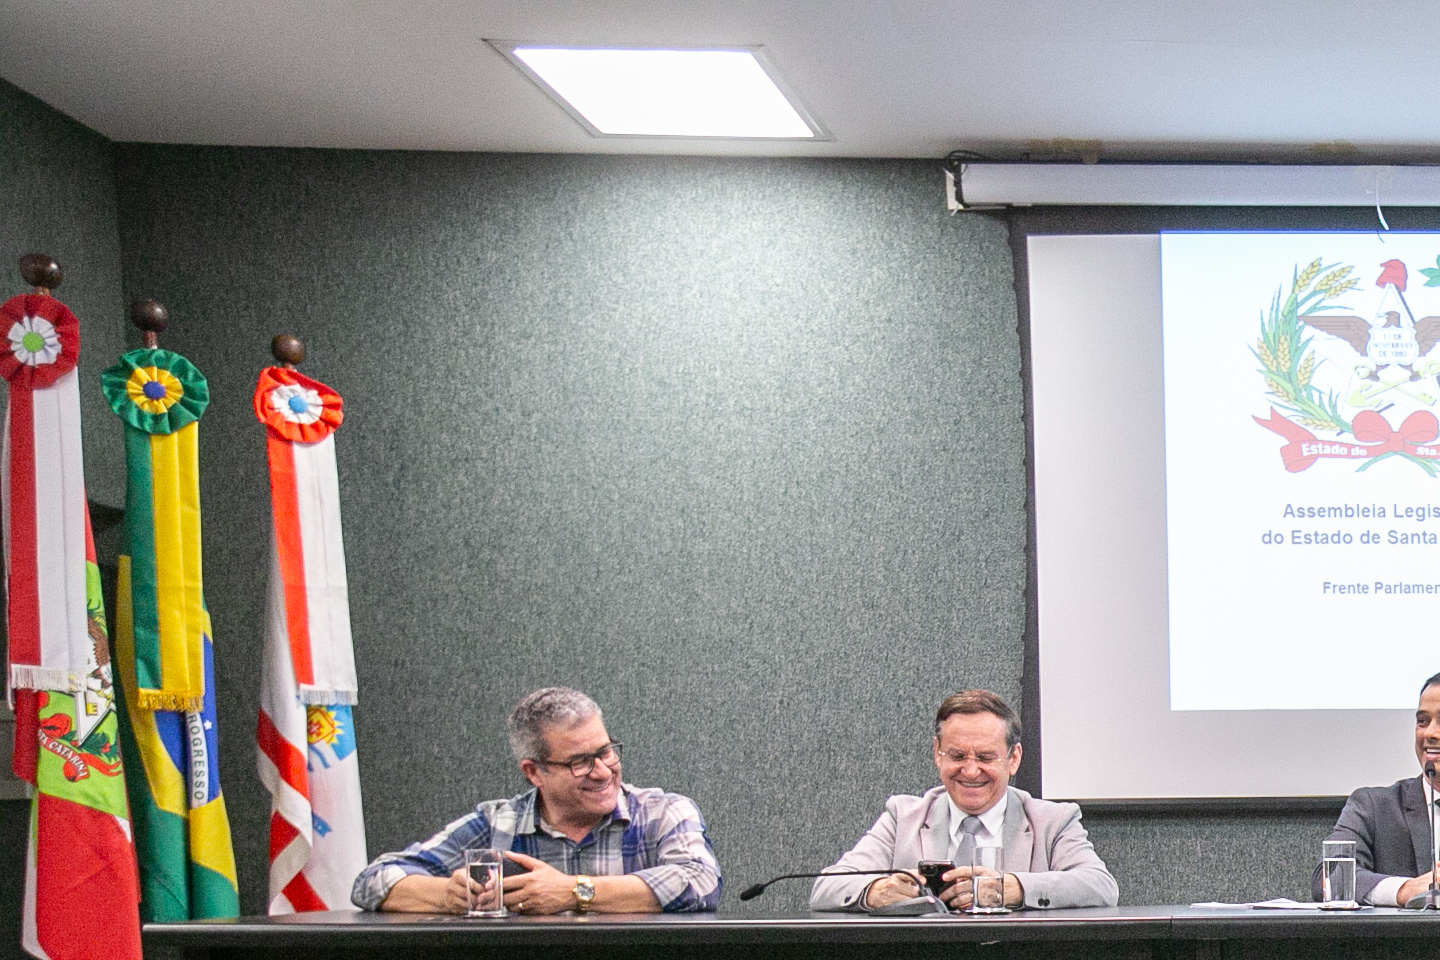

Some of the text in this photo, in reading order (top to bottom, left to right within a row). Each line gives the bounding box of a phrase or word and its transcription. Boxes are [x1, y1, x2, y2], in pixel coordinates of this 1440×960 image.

[1301, 442, 1368, 457] Estado de
[1415, 446, 1440, 456] Sta.
[1282, 503, 1387, 519] Assembleia
[1261, 529, 1285, 545] do
[1290, 529, 1353, 545] Estado
[1359, 529, 1381, 545] de
[1387, 529, 1438, 545] Santa
[1322, 581, 1370, 594] Frente
[48, 741, 88, 777] CATARINA
[188, 714, 205, 801] ROGRESSO
